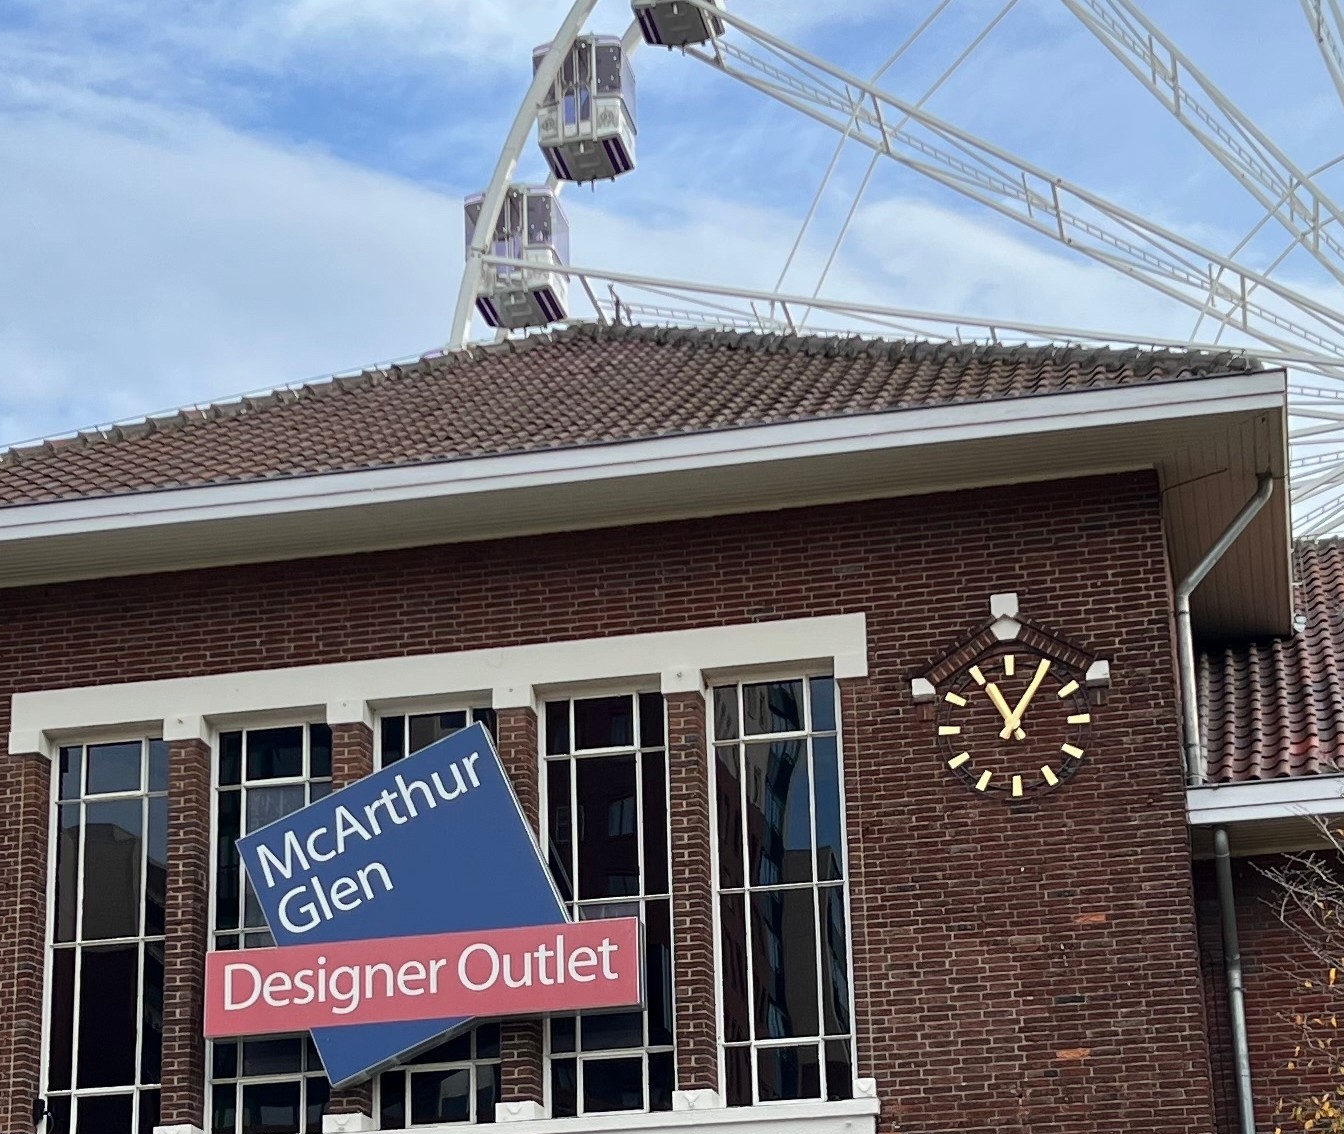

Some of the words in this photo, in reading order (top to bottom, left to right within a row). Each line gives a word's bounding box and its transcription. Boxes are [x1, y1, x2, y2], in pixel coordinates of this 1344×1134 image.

[256, 751, 480, 888] McArthur
[277, 861, 394, 934] Glen
[223, 956, 447, 1014] Designer
[457, 934, 619, 992] Outlet
